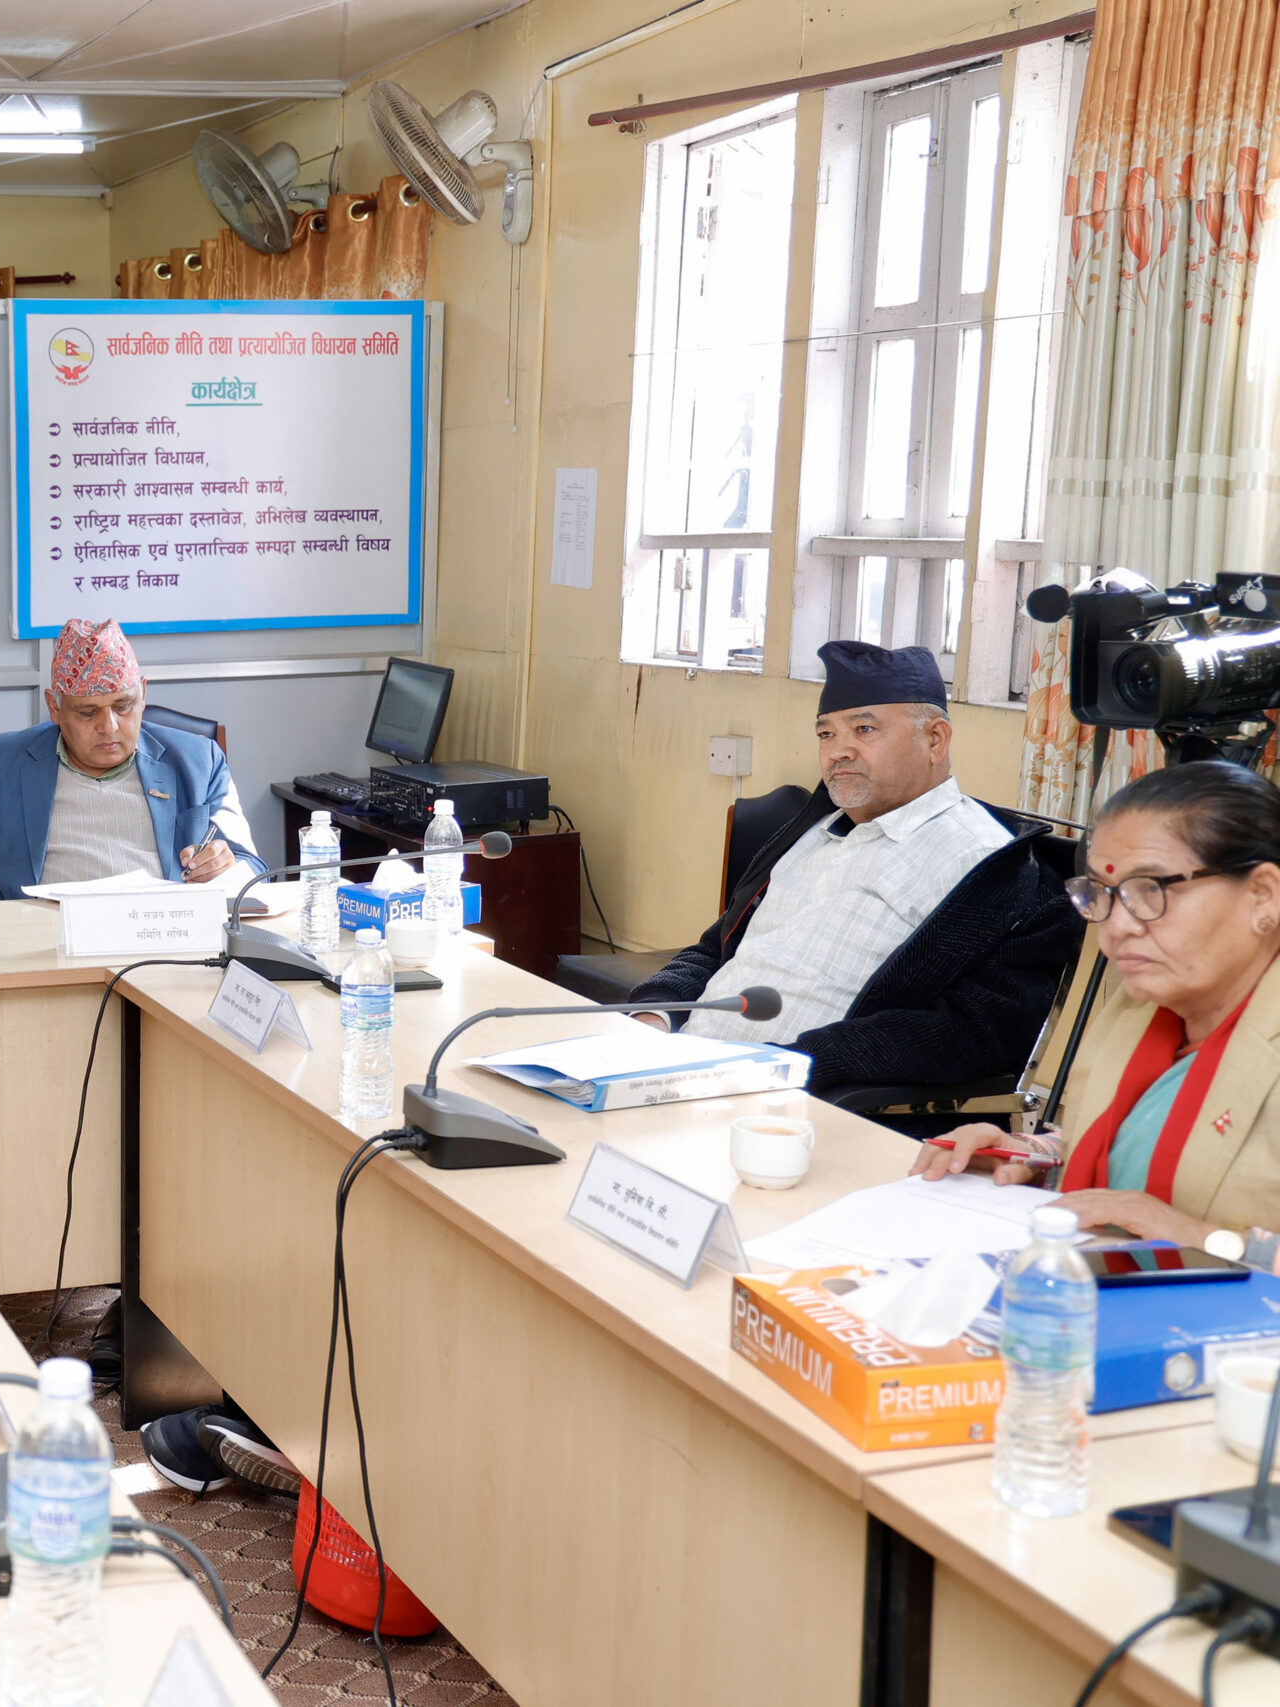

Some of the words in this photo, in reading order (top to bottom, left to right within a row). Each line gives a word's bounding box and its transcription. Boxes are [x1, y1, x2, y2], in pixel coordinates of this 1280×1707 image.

[106, 331, 170, 357] सार्वजनिक
[175, 331, 204, 356] नीति
[208, 337, 233, 356] तथा
[238, 331, 307, 357] प्रत्यायोजित
[311, 331, 357, 356] विधायन
[362, 331, 400, 357] समिति
[191, 375, 257, 401] कार्यक्षेत्र
[72, 416, 139, 438] सार्वजनिक
[146, 416, 181, 438] नीति,
[72, 447, 148, 469] प्रत्यायोजित
[154, 447, 210, 468] विधायन,
[72, 478, 127, 500] सरकारी
[134, 482, 194, 498] आश्वासन
[201, 476, 249, 496] सम्बन्धी
[256, 476, 288, 496] कार्य,
[73, 509, 121, 534] राष्ट्रिय
[190, 507, 247, 528] दस्तावेज,
[255, 506, 307, 525] अभिलेख
[314, 509, 383, 526] व्यवस्थापन,
[73, 540, 141, 564] ऐतिहासिक
[148, 540, 169, 561] एवं
[256, 540, 296, 557] सम्पदा
[302, 534, 350, 555] सम्बन्धी
[356, 533, 391, 552] विषय
[73, 576, 85, 593] र
[90, 574, 130, 591] सम्बद्ध
[136, 569, 180, 588] निकाय
[337, 896, 381, 919] PREMIUM
[734, 1293, 833, 1398] PREMIUM
[878, 1380, 1001, 1413] PREMIUM
